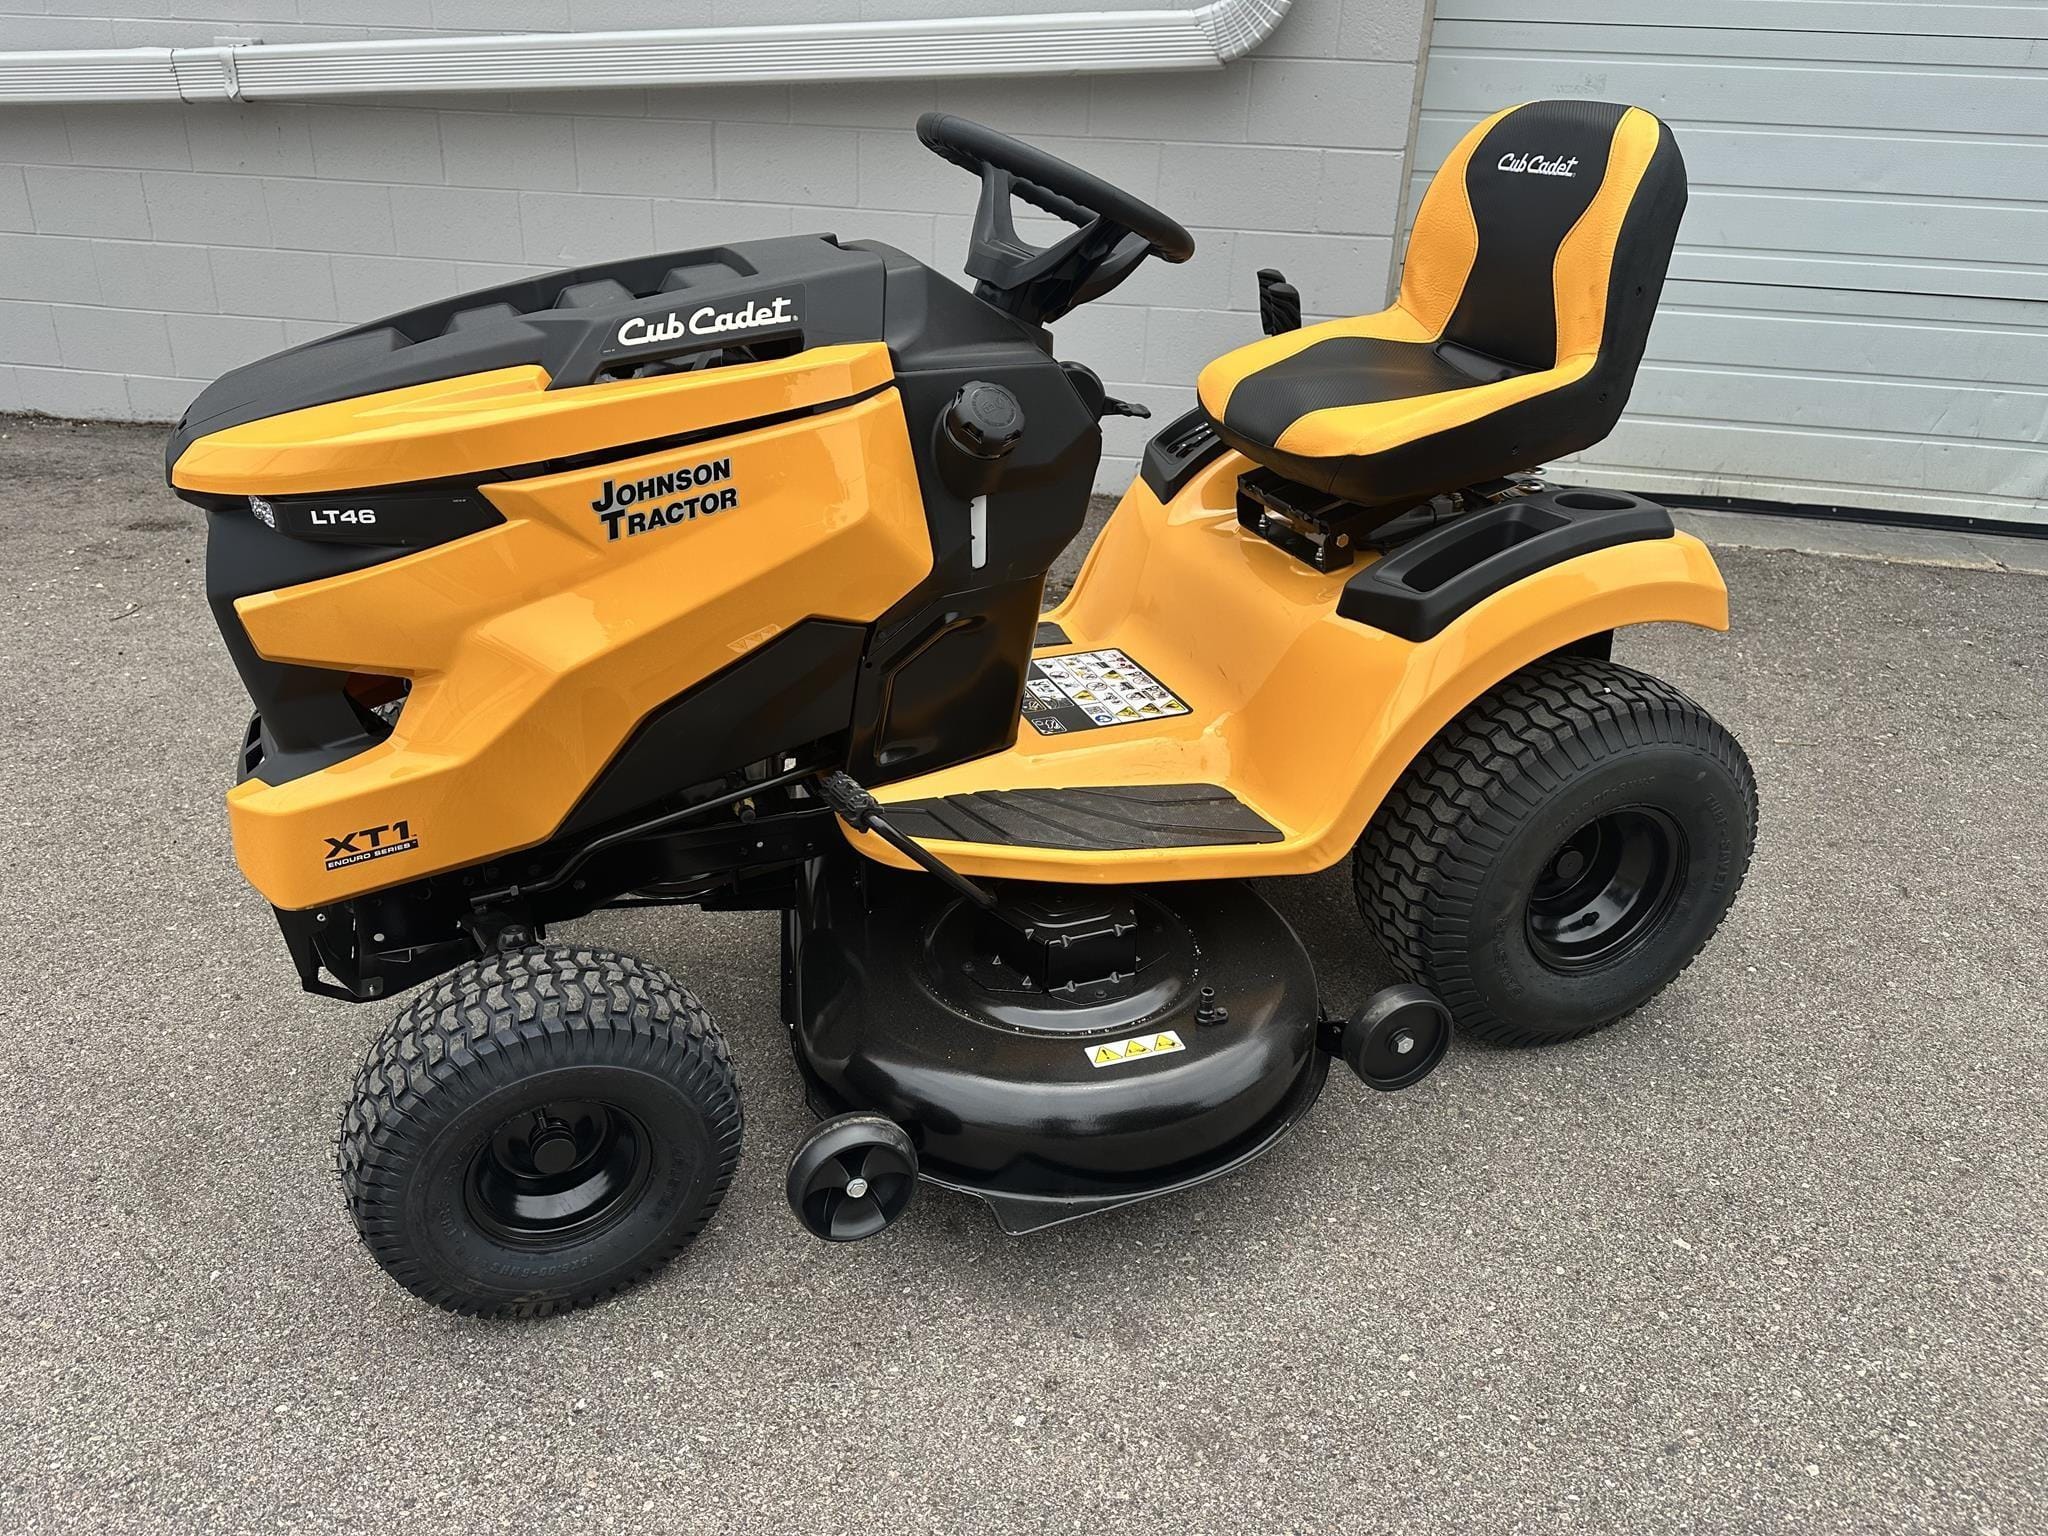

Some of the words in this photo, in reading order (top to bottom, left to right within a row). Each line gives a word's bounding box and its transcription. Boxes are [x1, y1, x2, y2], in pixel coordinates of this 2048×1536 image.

[1498, 153, 1529, 173] Cub
[1527, 155, 1579, 178] Cadet
[617, 312, 685, 346] Cub
[689, 297, 792, 335] Cadet
[592, 458, 731, 513] JOHNSON
[310, 509, 377, 525] LT46
[601, 488, 738, 541] TRACTOR
[324, 820, 410, 859] XT1
[327, 853, 372, 869] ENDURO
[374, 842, 411, 857] SERIES
